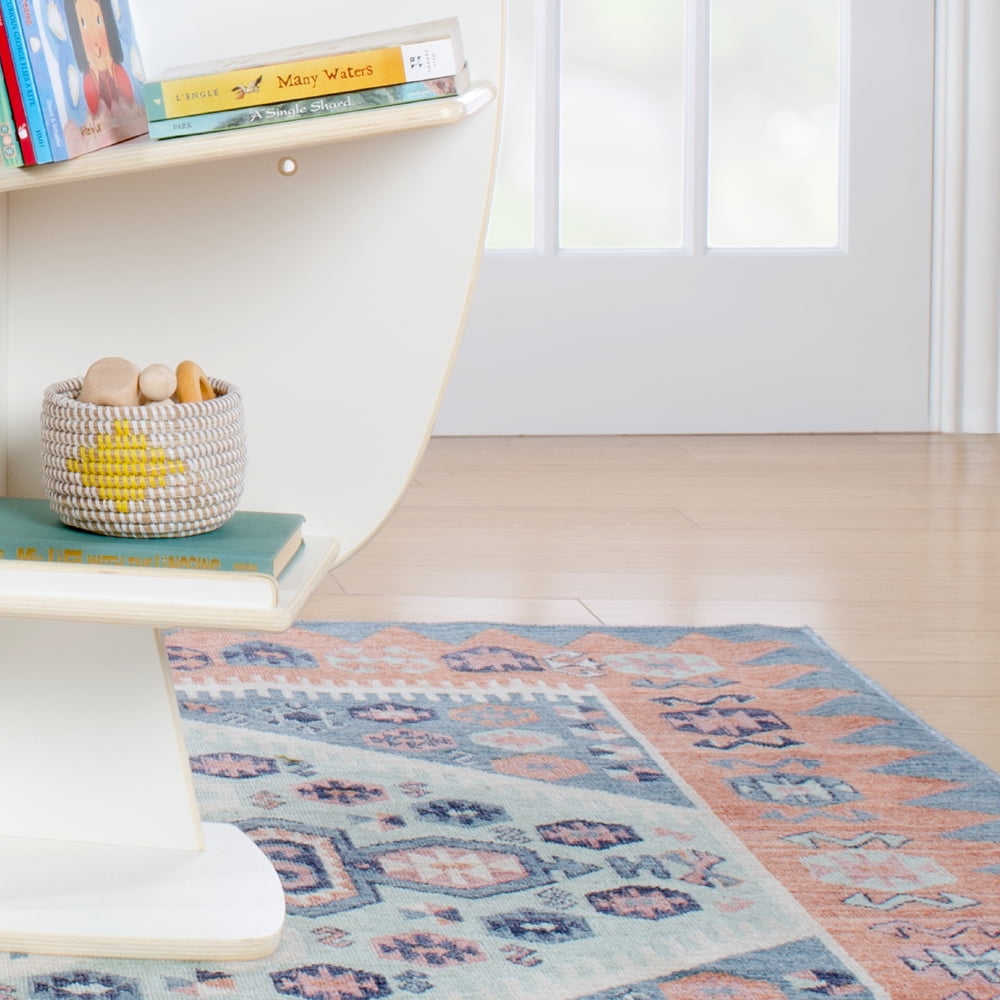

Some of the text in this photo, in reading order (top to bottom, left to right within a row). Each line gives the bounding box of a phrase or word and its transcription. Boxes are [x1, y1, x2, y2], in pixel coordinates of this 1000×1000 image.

[13, 30, 25, 61] GEORGE
[20, 62, 30, 82] FLIES
[26, 89, 35, 107] KITE
[276, 63, 374, 89] Many Waters
[175, 89, 220, 102] L'ENGLE
[250, 95, 352, 122] A Single Shard
[172, 122, 193, 131] PARK
